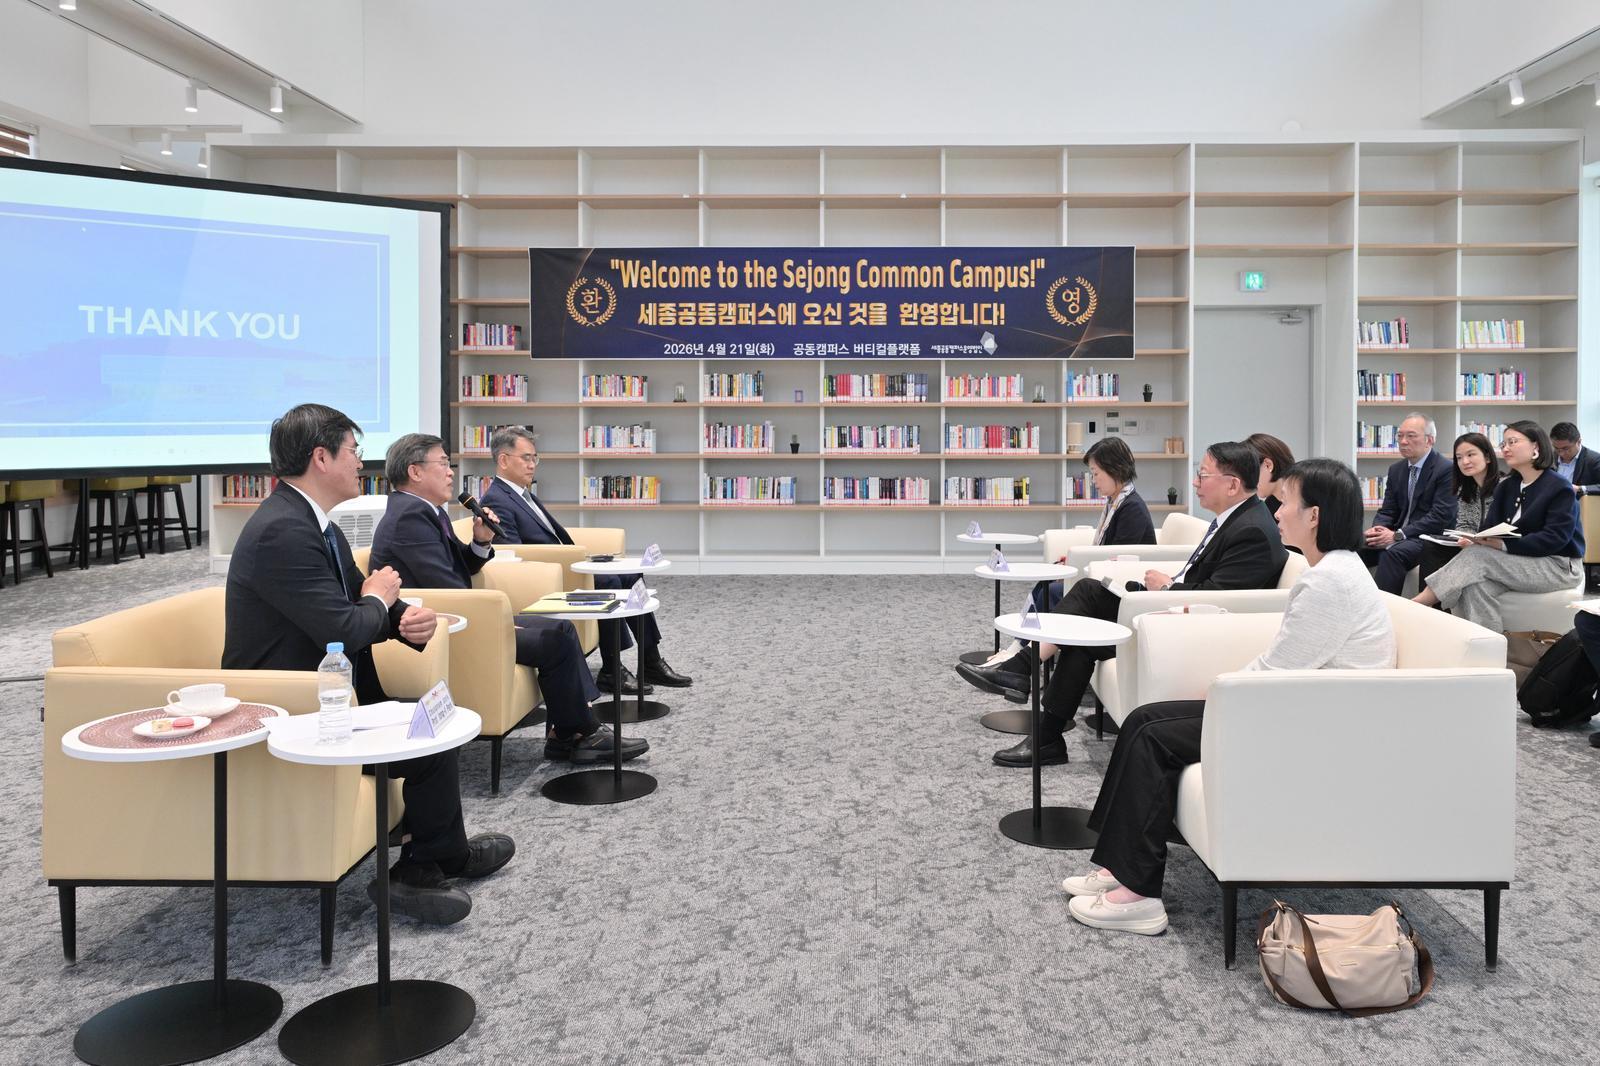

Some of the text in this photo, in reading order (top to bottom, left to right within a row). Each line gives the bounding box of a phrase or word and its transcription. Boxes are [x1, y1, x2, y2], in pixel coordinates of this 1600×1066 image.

[610, 258, 1046, 294] "Welcome to the Sejong Common Campus!"
[581, 288, 603, 314] 환
[1062, 287, 1081, 314] 영
[78, 304, 300, 340] THANK YOU
[638, 302, 1006, 326] 세종공동캠퍼스에 오신 것을 환영합니다!
[663, 342, 921, 356] 2026년 4월 21일(화) 공동캠퍼스 버티컬플랫폼
